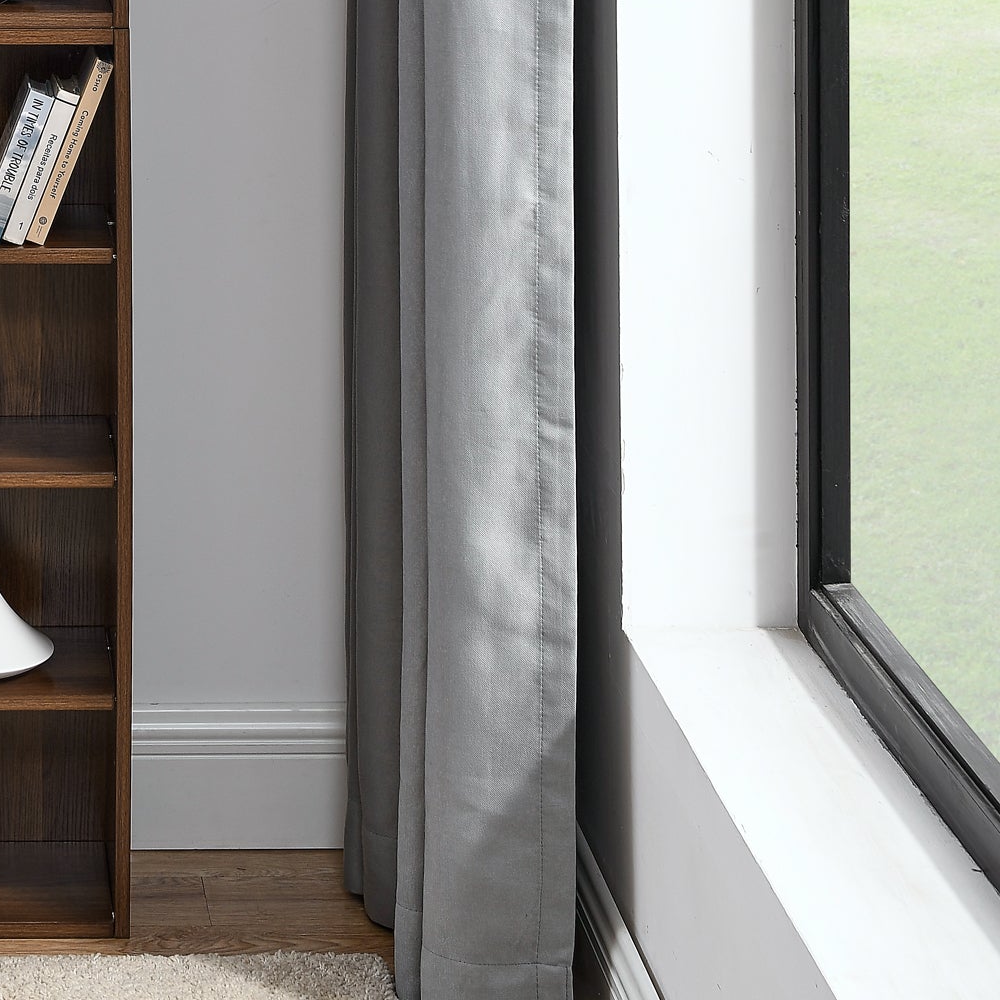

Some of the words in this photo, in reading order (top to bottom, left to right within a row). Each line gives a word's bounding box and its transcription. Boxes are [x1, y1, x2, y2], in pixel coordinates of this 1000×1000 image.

[92, 73, 103, 92] OSHO
[31, 98, 44, 111] IN
[20, 112, 40, 138] TIMES
[71, 110, 89, 137] Coming
[16, 139, 29, 153] OF
[39, 133, 58, 166] Receitas
[64, 138, 78, 160] Home
[0, 152, 24, 193] TROUBLE
[33, 165, 44, 184] para
[61, 160, 69, 169] to
[27, 184, 39, 201] dois
[49, 170, 66, 200] Yourself
